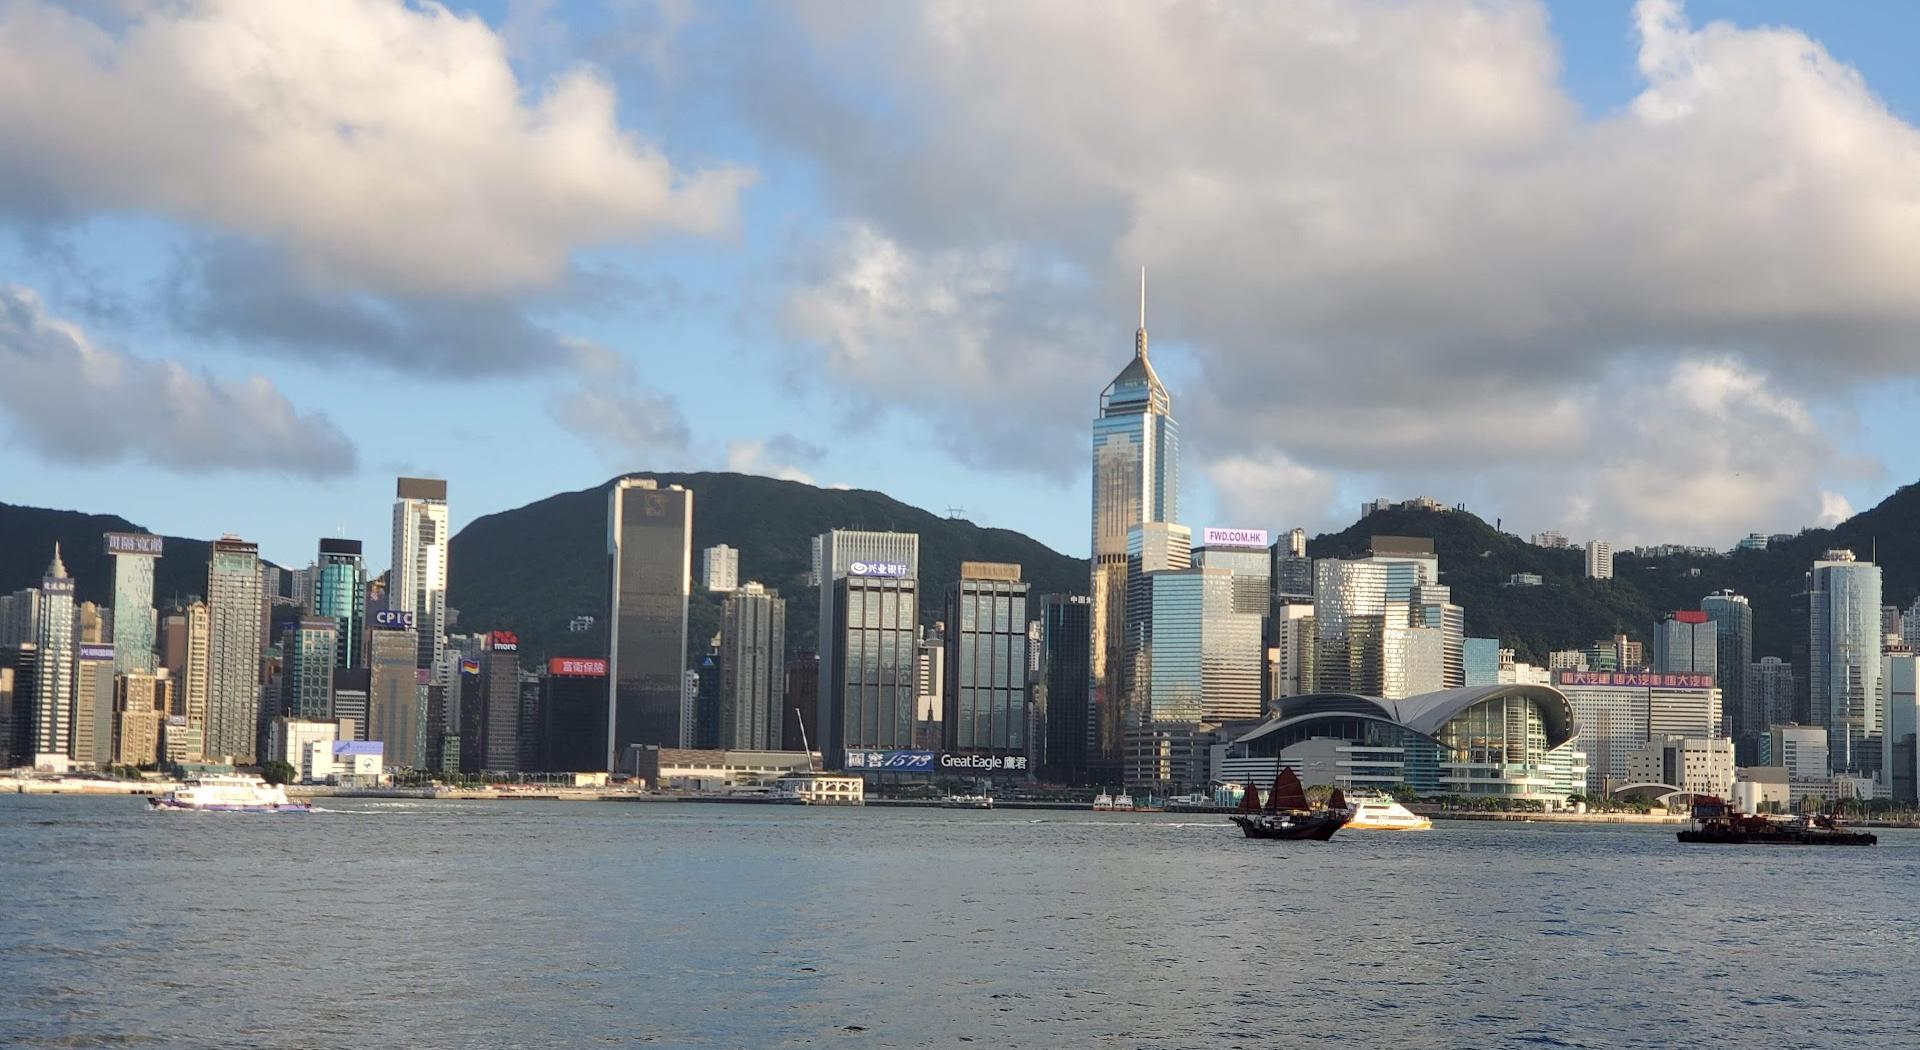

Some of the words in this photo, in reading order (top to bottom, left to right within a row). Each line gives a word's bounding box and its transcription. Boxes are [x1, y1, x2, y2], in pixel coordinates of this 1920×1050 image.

[1210, 531, 1261, 543] FWD.COM.HK
[376, 611, 413, 625] CPIC
[494, 642, 517, 651] more
[941, 754, 971, 767] Great
[972, 754, 1002, 771] Eagle
